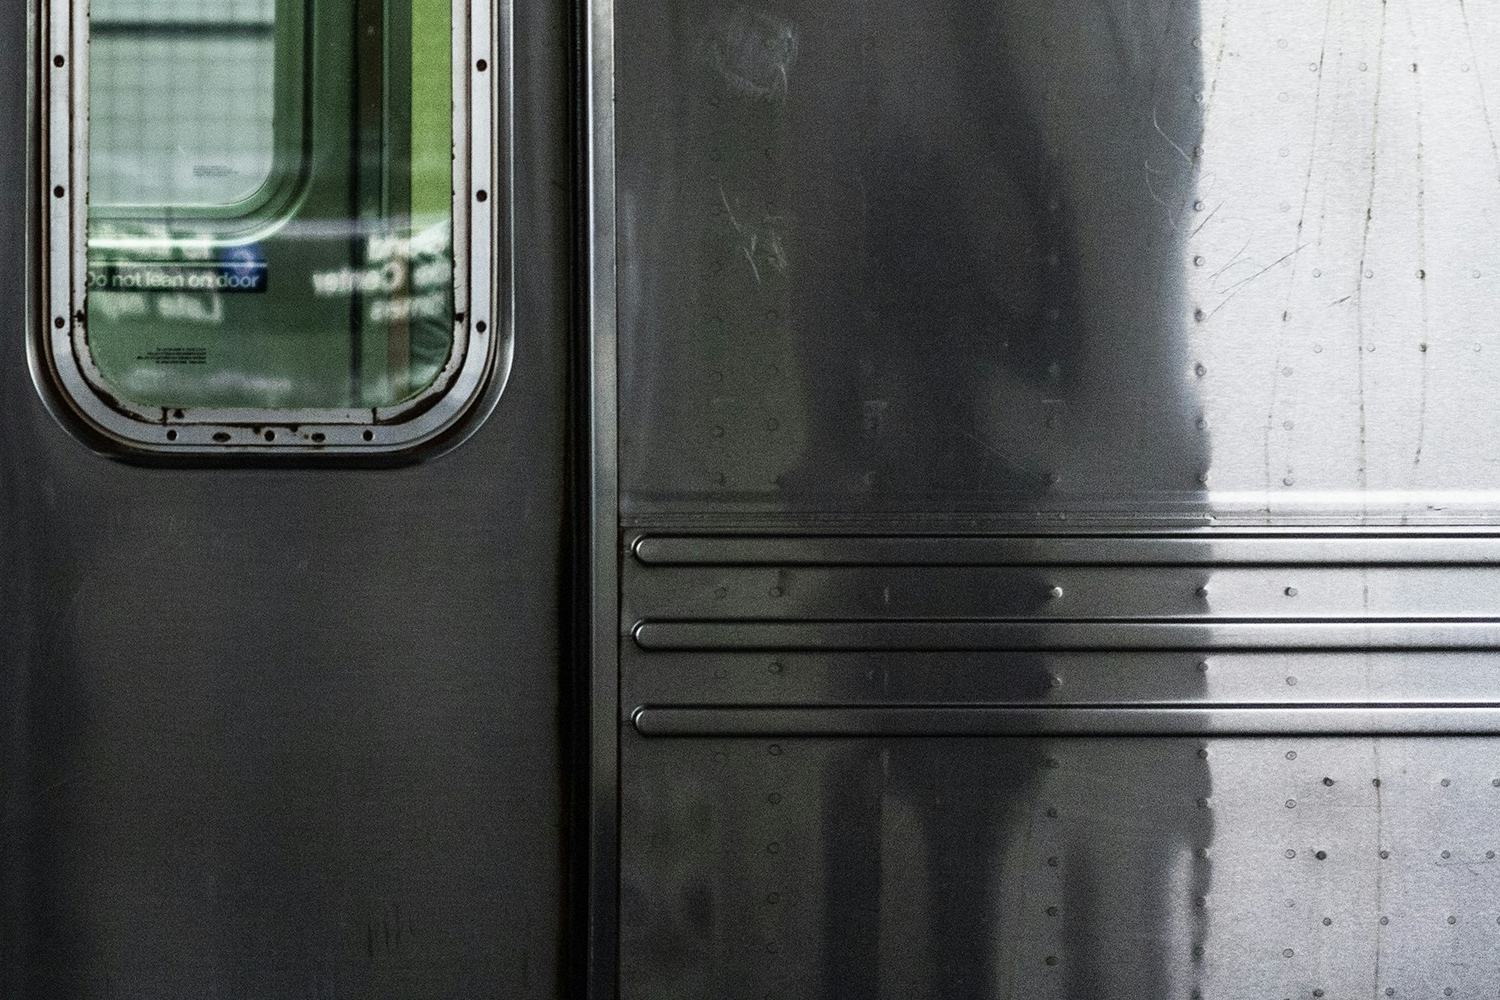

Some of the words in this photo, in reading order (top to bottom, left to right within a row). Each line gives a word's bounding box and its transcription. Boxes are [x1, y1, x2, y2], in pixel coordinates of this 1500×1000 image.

[112, 272, 142, 288] not
[145, 271, 185, 288] lean
[187, 274, 213, 288] on
[217, 272, 260, 288] door
